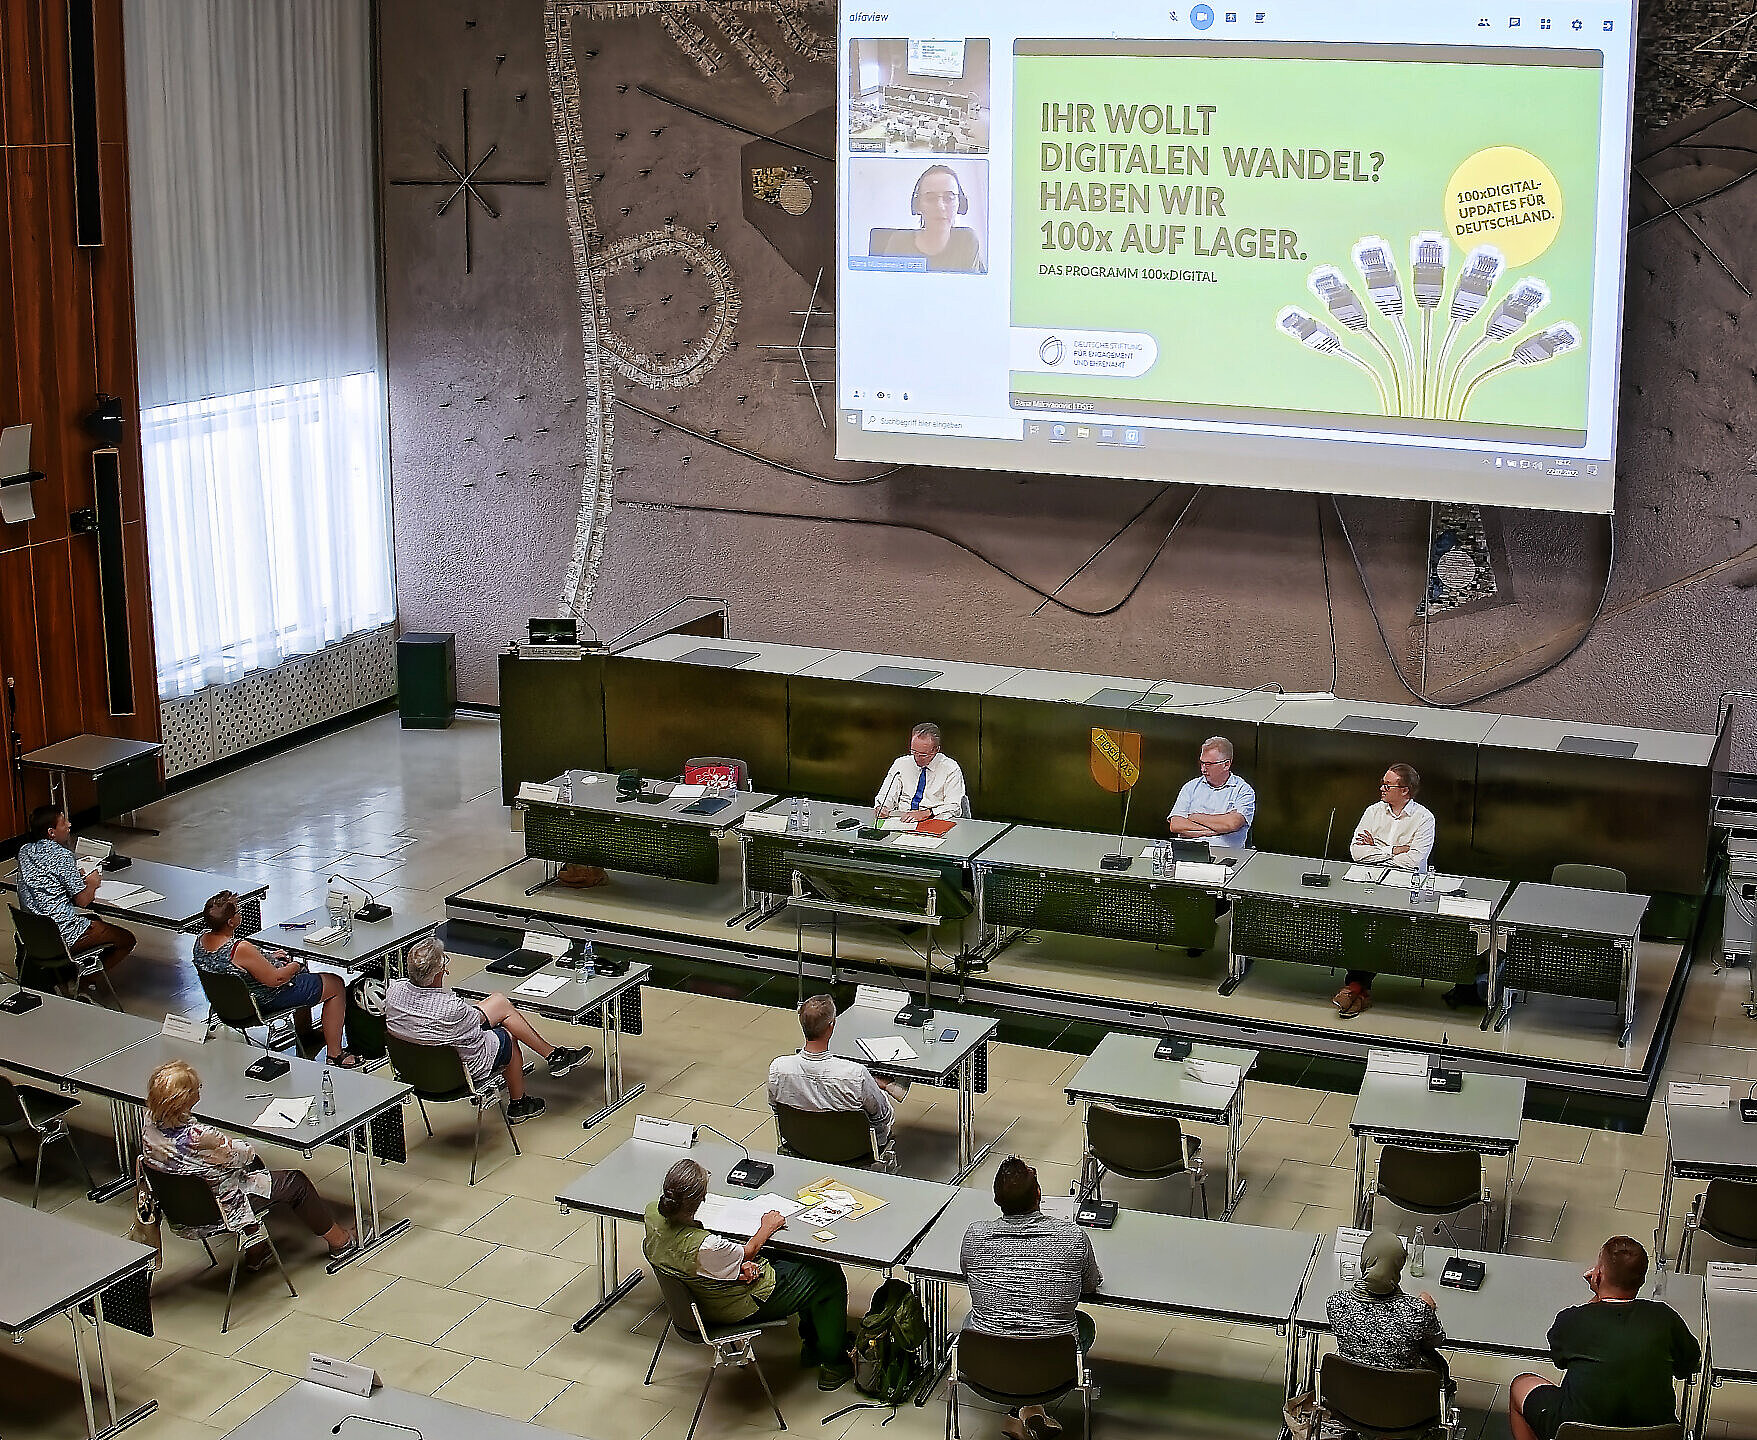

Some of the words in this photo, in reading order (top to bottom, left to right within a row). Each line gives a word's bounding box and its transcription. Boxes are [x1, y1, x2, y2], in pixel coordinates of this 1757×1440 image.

[849, 11, 889, 22] alfaview
[1041, 102, 1096, 133] IHR
[1104, 103, 1217, 136] WOLLT
[1040, 142, 1209, 176] DIGITALEN
[1223, 146, 1386, 182] WANDEL?
[1040, 181, 1150, 213] HABEN
[1159, 184, 1226, 217] WIR
[1457, 179, 1542, 204] 100xDIGITAL-
[1458, 199, 1517, 219] UPDATES
[1519, 193, 1546, 208] FÜR
[1455, 209, 1555, 236] DEUTSCHLAND.
[1040, 220, 1113, 252] 100x
[1121, 223, 1186, 255] AUF
[1194, 226, 1308, 261] LAGER.
[1039, 264, 1063, 276] DAS
[1065, 265, 1139, 279] PROGRAMM
[1141, 268, 1218, 283] 100xDIGITAL
[1073, 349, 1088, 357] FÜR
[1088, 351, 1134, 360] ENGAGEMENT
[1073, 359, 1089, 367] UND
[880, 417, 918, 428] Suchbegriff
[932, 420, 963, 429] eingeben
